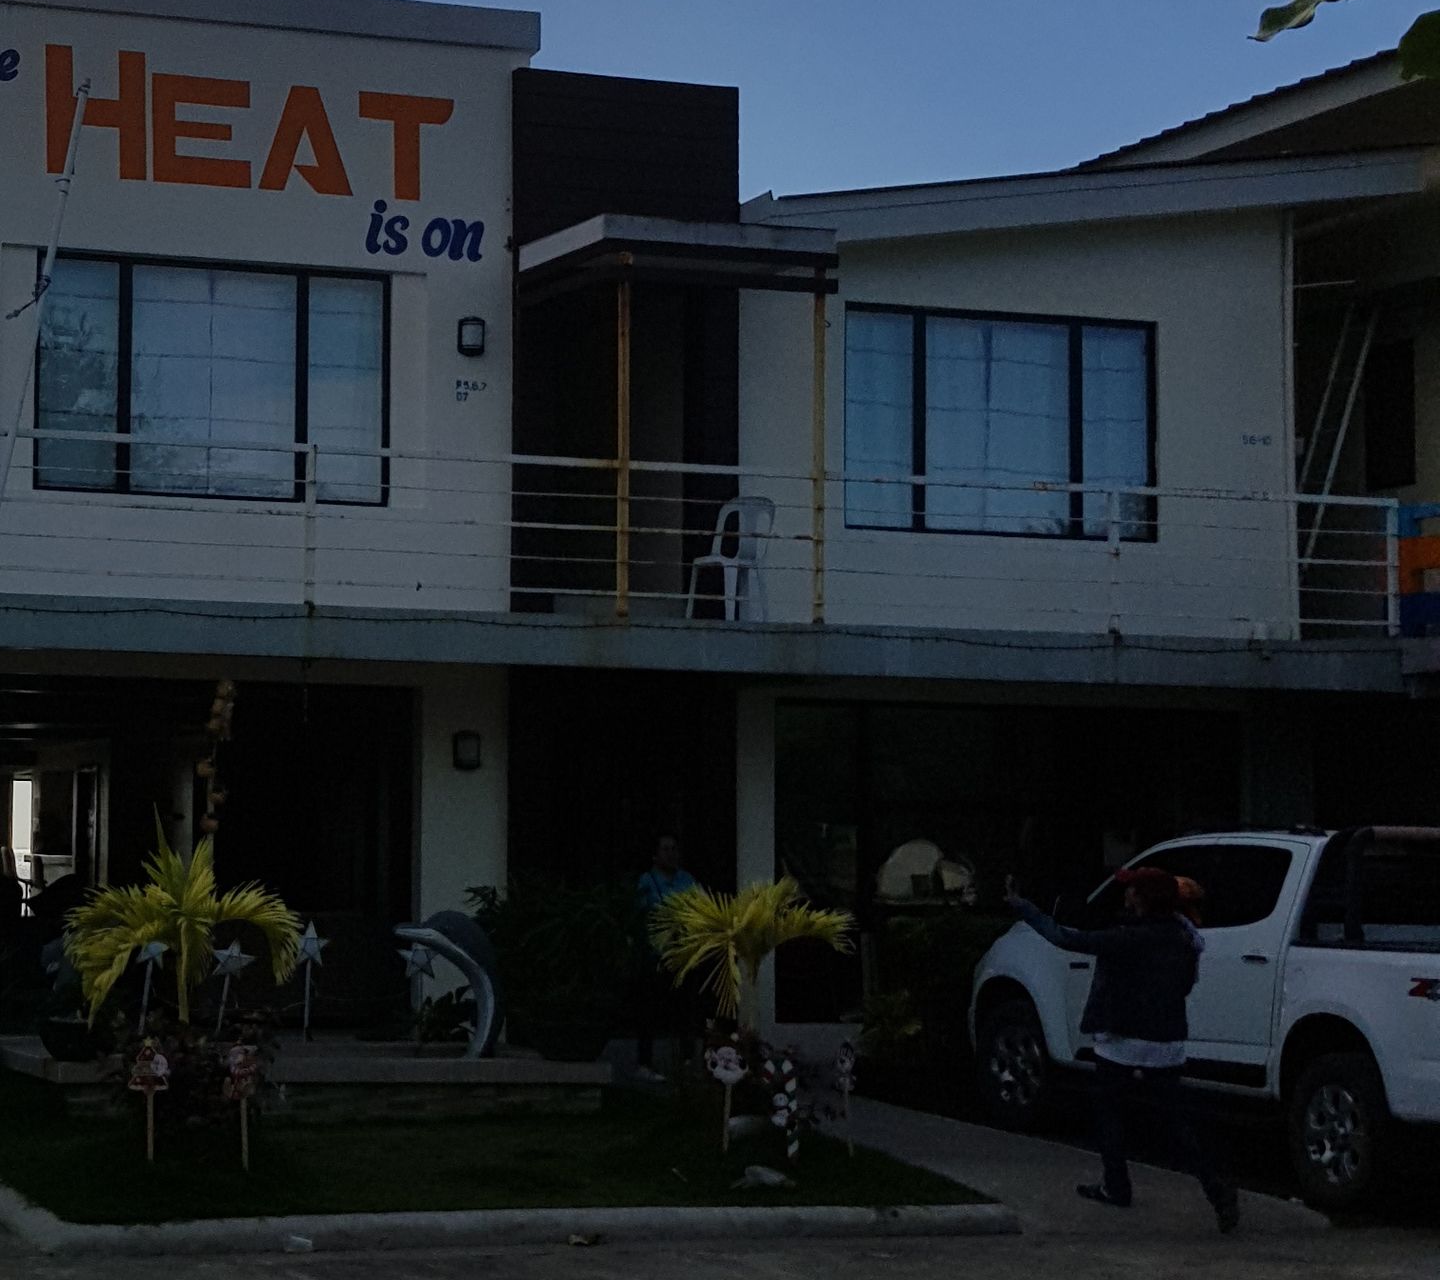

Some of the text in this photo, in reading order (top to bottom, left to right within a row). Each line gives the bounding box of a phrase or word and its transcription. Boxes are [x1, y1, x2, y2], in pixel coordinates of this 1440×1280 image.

[45, 43, 455, 201] HEAT
[364, 198, 485, 263] is on
